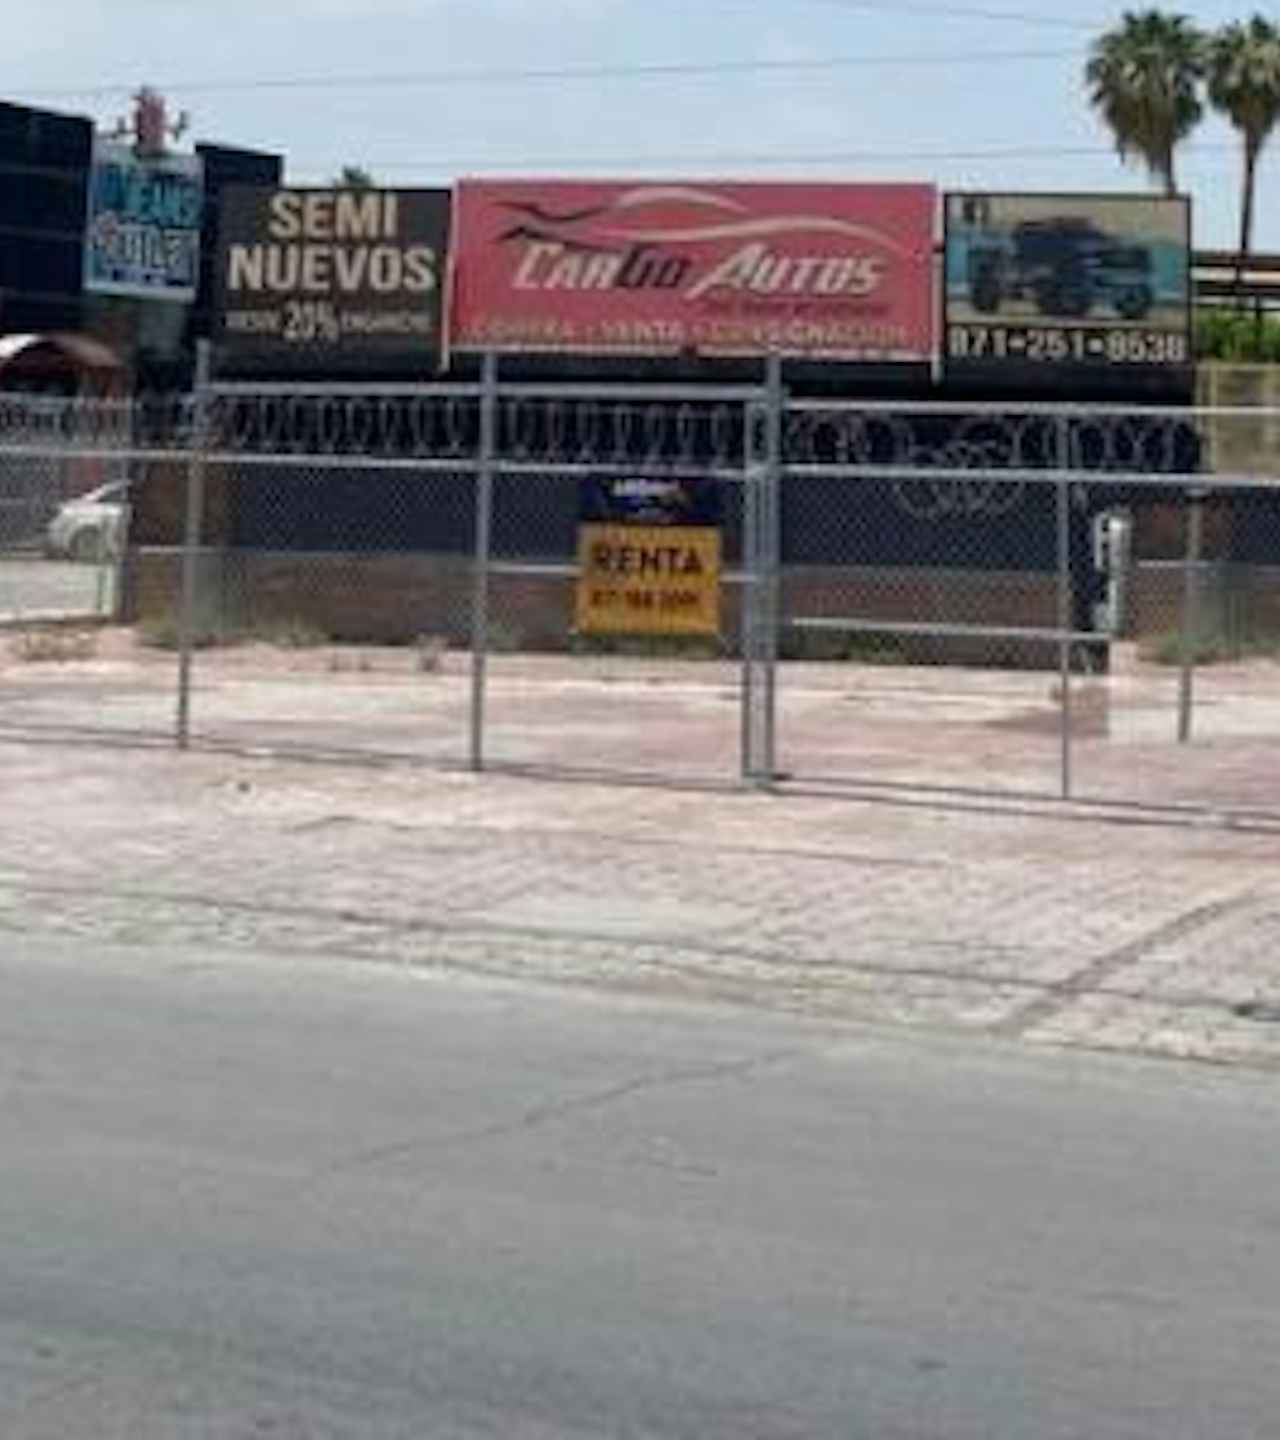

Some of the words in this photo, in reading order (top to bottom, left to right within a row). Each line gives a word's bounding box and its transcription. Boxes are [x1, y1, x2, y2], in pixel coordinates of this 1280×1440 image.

[269, 191, 398, 240] SEMI
[228, 243, 437, 292] NUEVOS
[591, 543, 703, 574] RENTA
